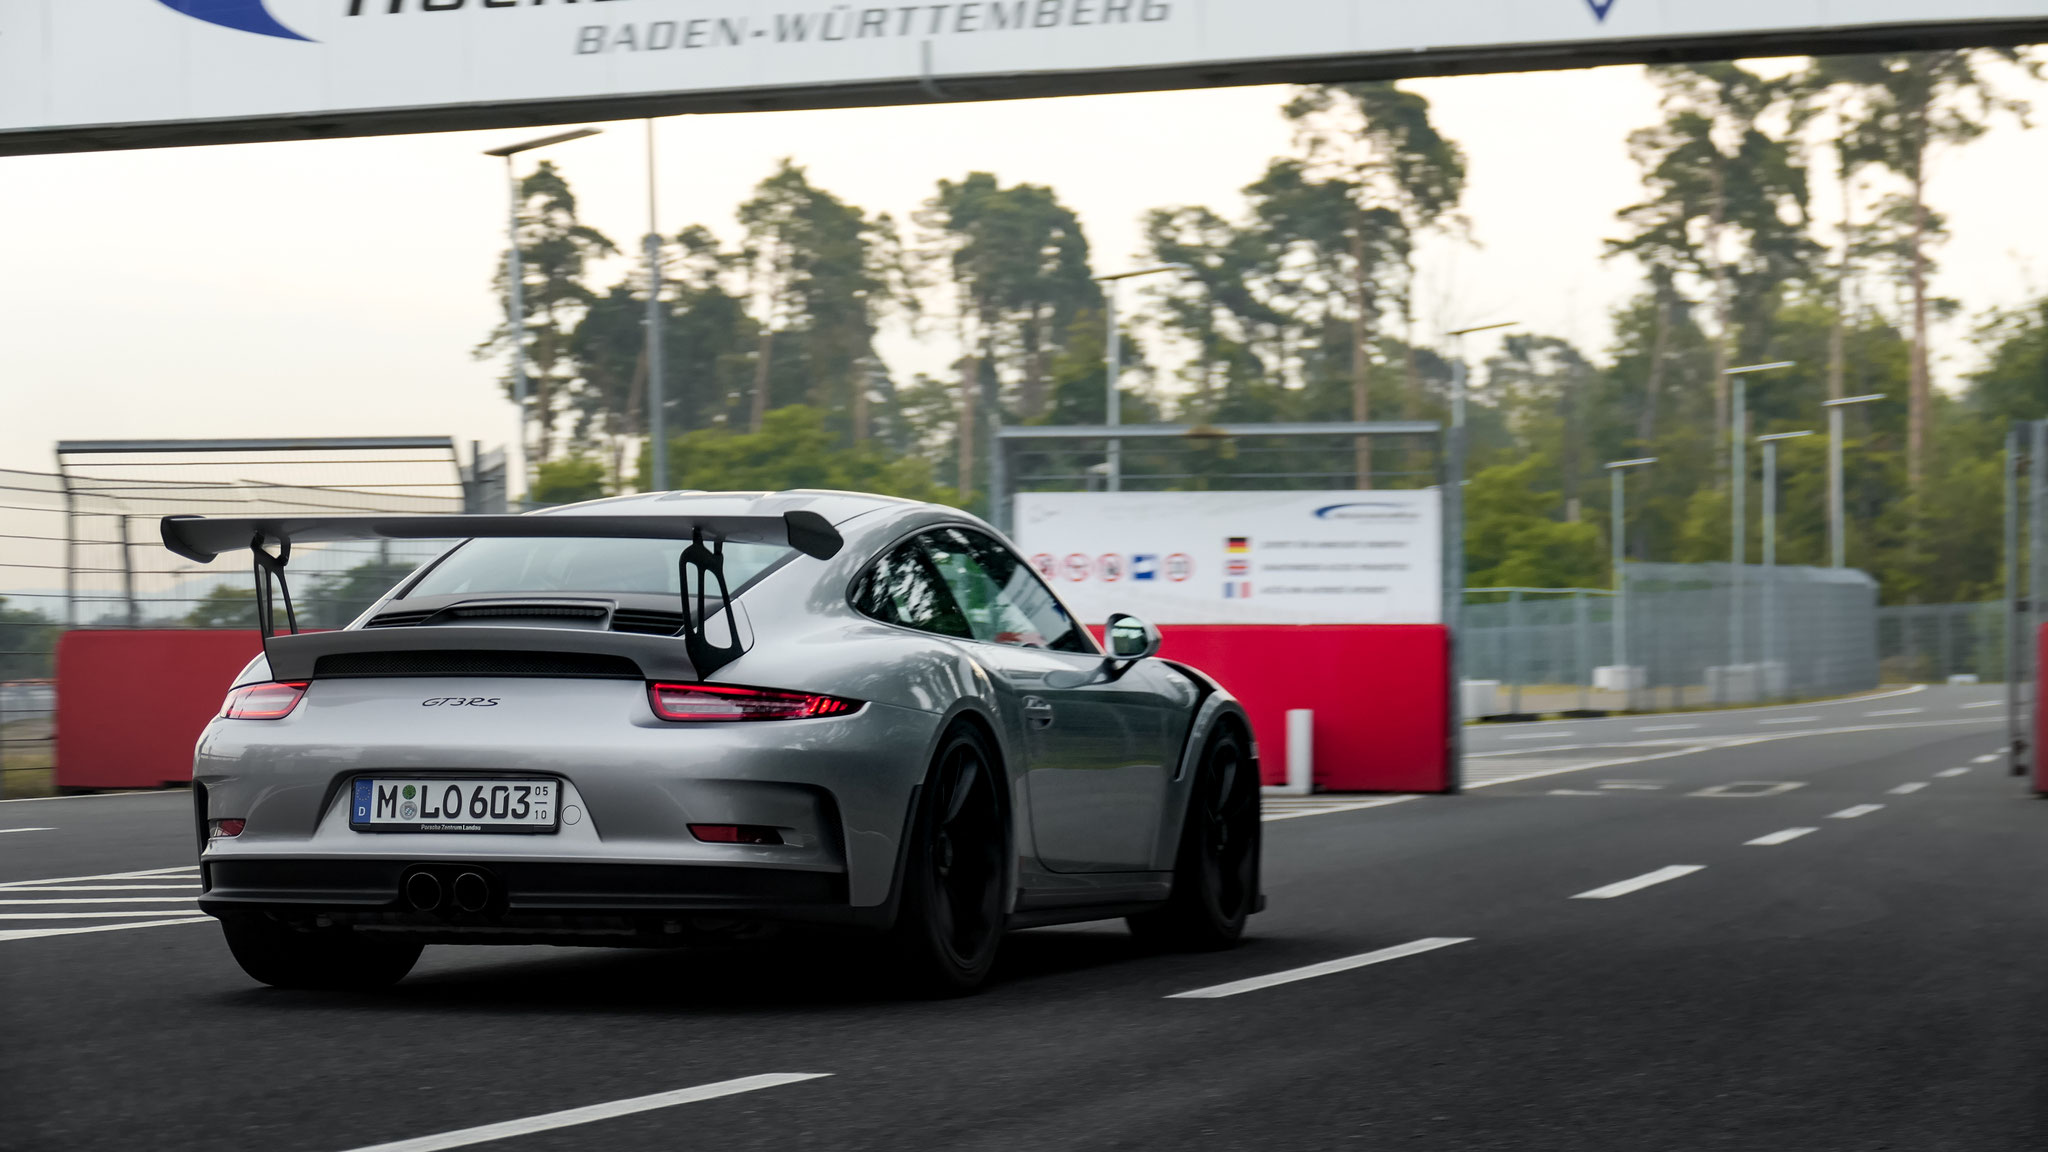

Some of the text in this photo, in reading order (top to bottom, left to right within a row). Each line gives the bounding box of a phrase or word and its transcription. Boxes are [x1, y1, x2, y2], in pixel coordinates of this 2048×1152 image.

[574, 0, 1173, 55] BADEN-WÜRTTEMBERG
[535, 786, 548, 796] 05
[377, 784, 531, 819] M LO 603
[358, 806, 366, 816] D
[535, 810, 547, 820] 10
